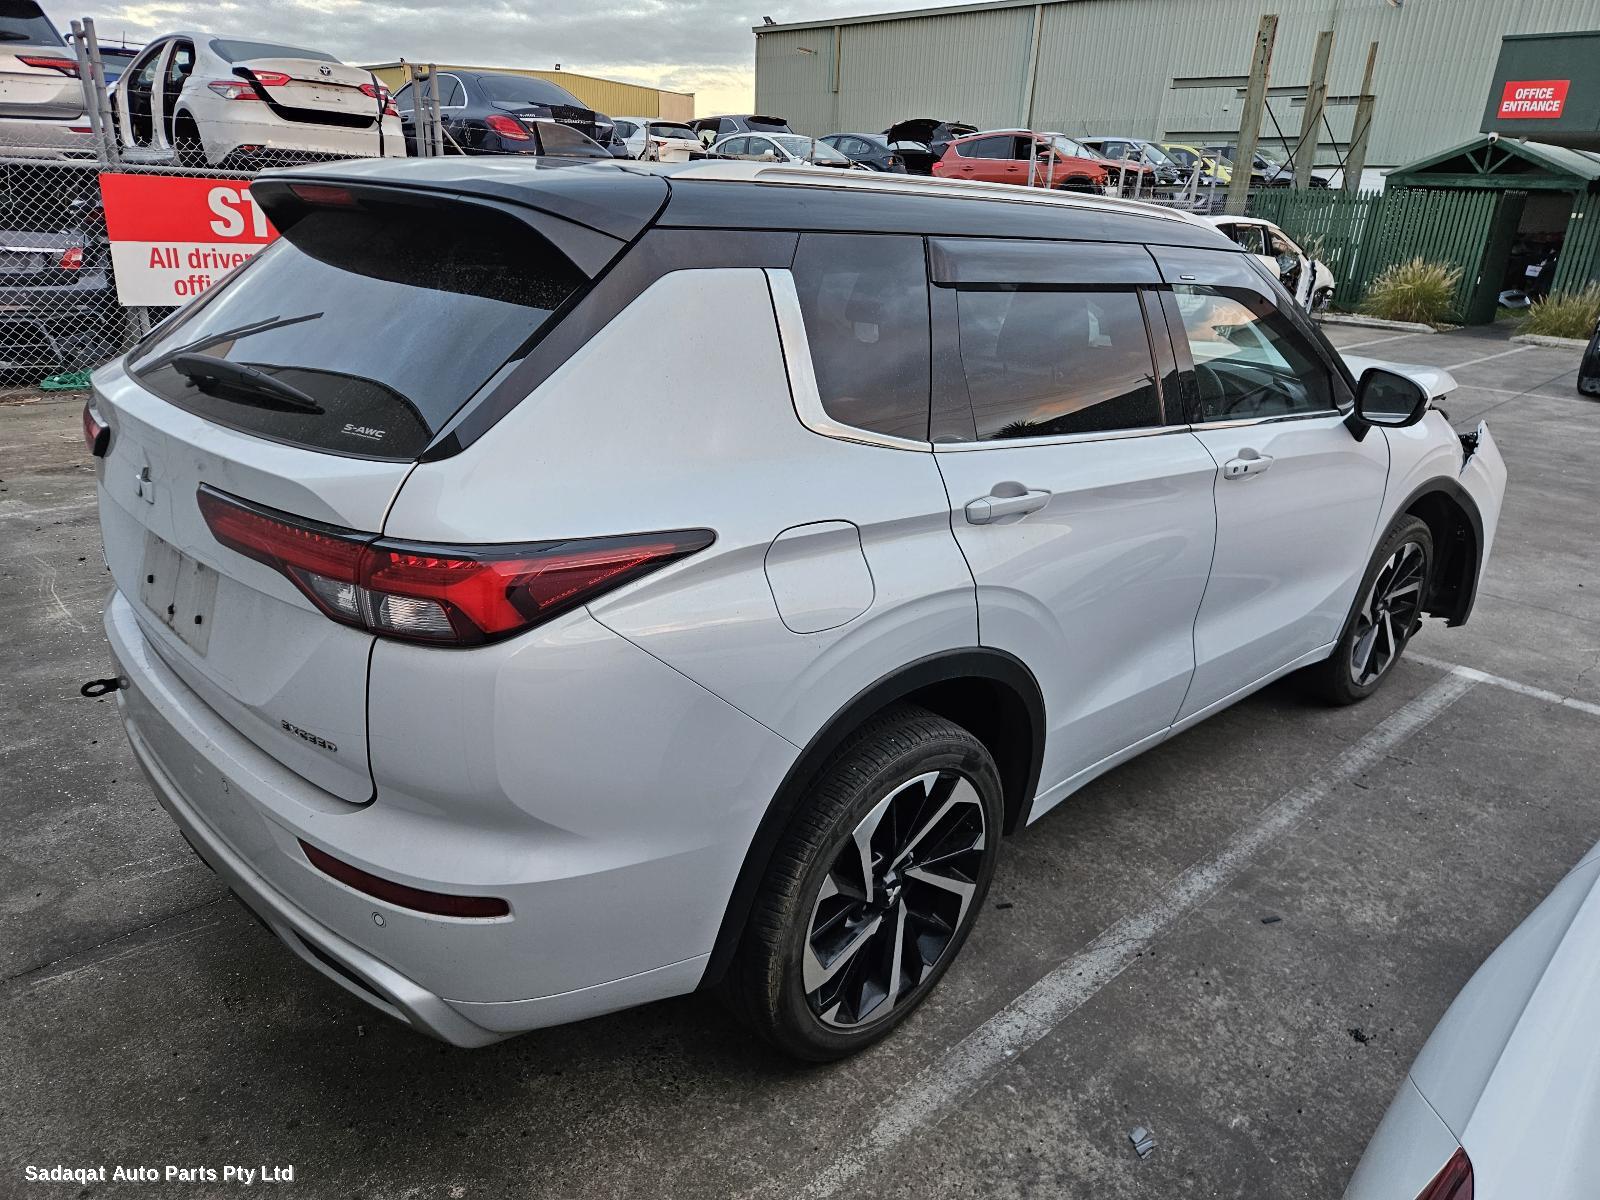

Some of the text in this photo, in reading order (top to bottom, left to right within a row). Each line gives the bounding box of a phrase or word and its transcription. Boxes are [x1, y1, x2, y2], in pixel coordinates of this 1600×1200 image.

[1515, 87, 1554, 99] OFFICE
[1502, 100, 1560, 112] ENTRANCE
[149, 247, 180, 269] All
[343, 423, 386, 438] S-AWC
